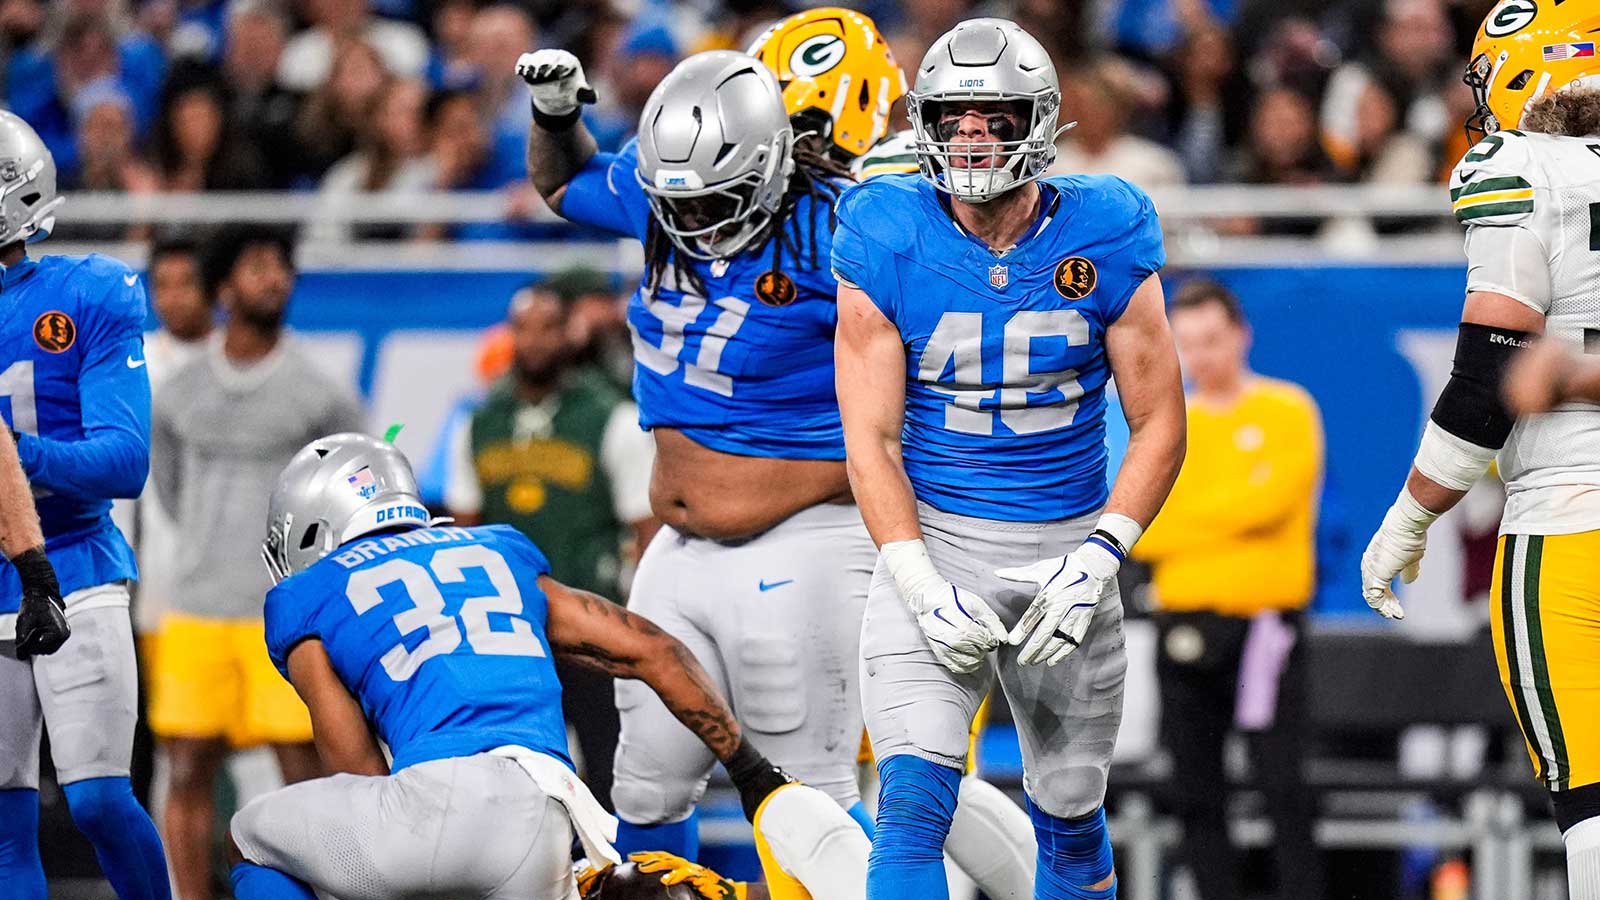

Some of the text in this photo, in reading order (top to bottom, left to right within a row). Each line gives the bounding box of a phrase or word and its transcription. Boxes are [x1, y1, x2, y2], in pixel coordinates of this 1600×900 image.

[627, 263, 751, 398] 91
[992, 275, 1005, 284] NFL
[917, 309, 1089, 435] 46
[331, 526, 475, 569] BRANCH
[345, 544, 547, 682] 32
